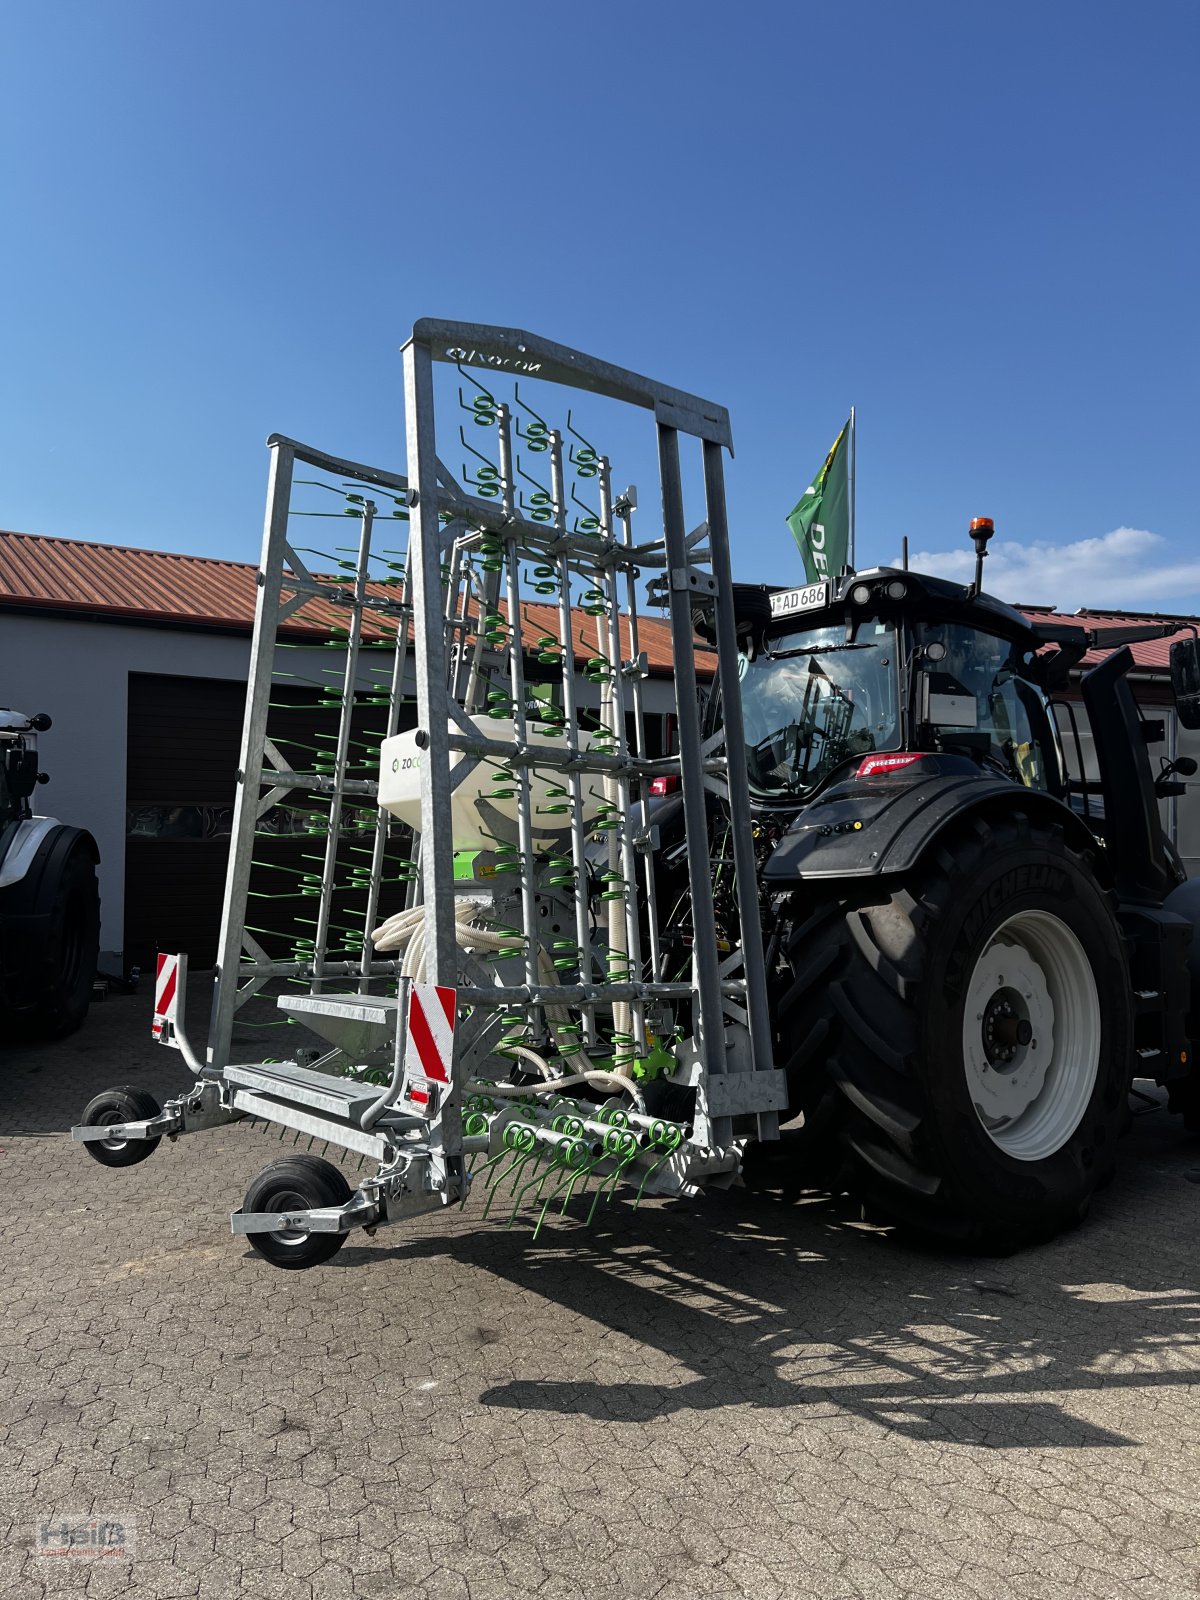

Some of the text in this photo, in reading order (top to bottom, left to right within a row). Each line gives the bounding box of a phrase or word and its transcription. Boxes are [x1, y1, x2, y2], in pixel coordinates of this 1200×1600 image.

[810, 522, 830, 581] DE
[782, 593, 799, 611] AD
[801, 587, 825, 606] 686
[961, 864, 1066, 946] MICHELIN
